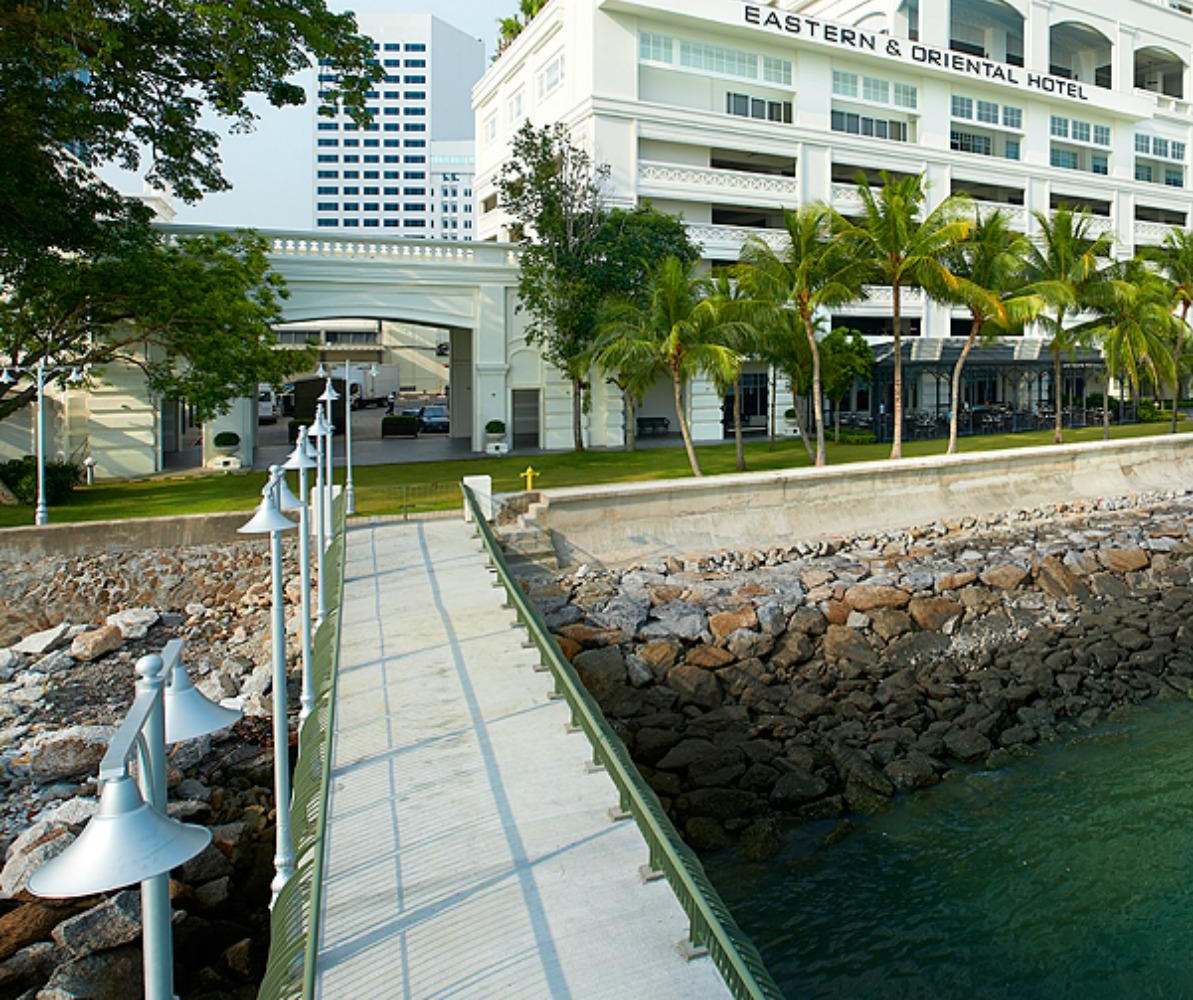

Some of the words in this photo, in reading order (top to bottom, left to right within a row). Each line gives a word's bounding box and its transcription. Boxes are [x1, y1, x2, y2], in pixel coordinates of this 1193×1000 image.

[744, 5, 876, 50] EASTERN
[885, 39, 902, 56] &
[911, 46, 1019, 84] ORIENTAL
[1027, 73, 1088, 100] HOTEL
